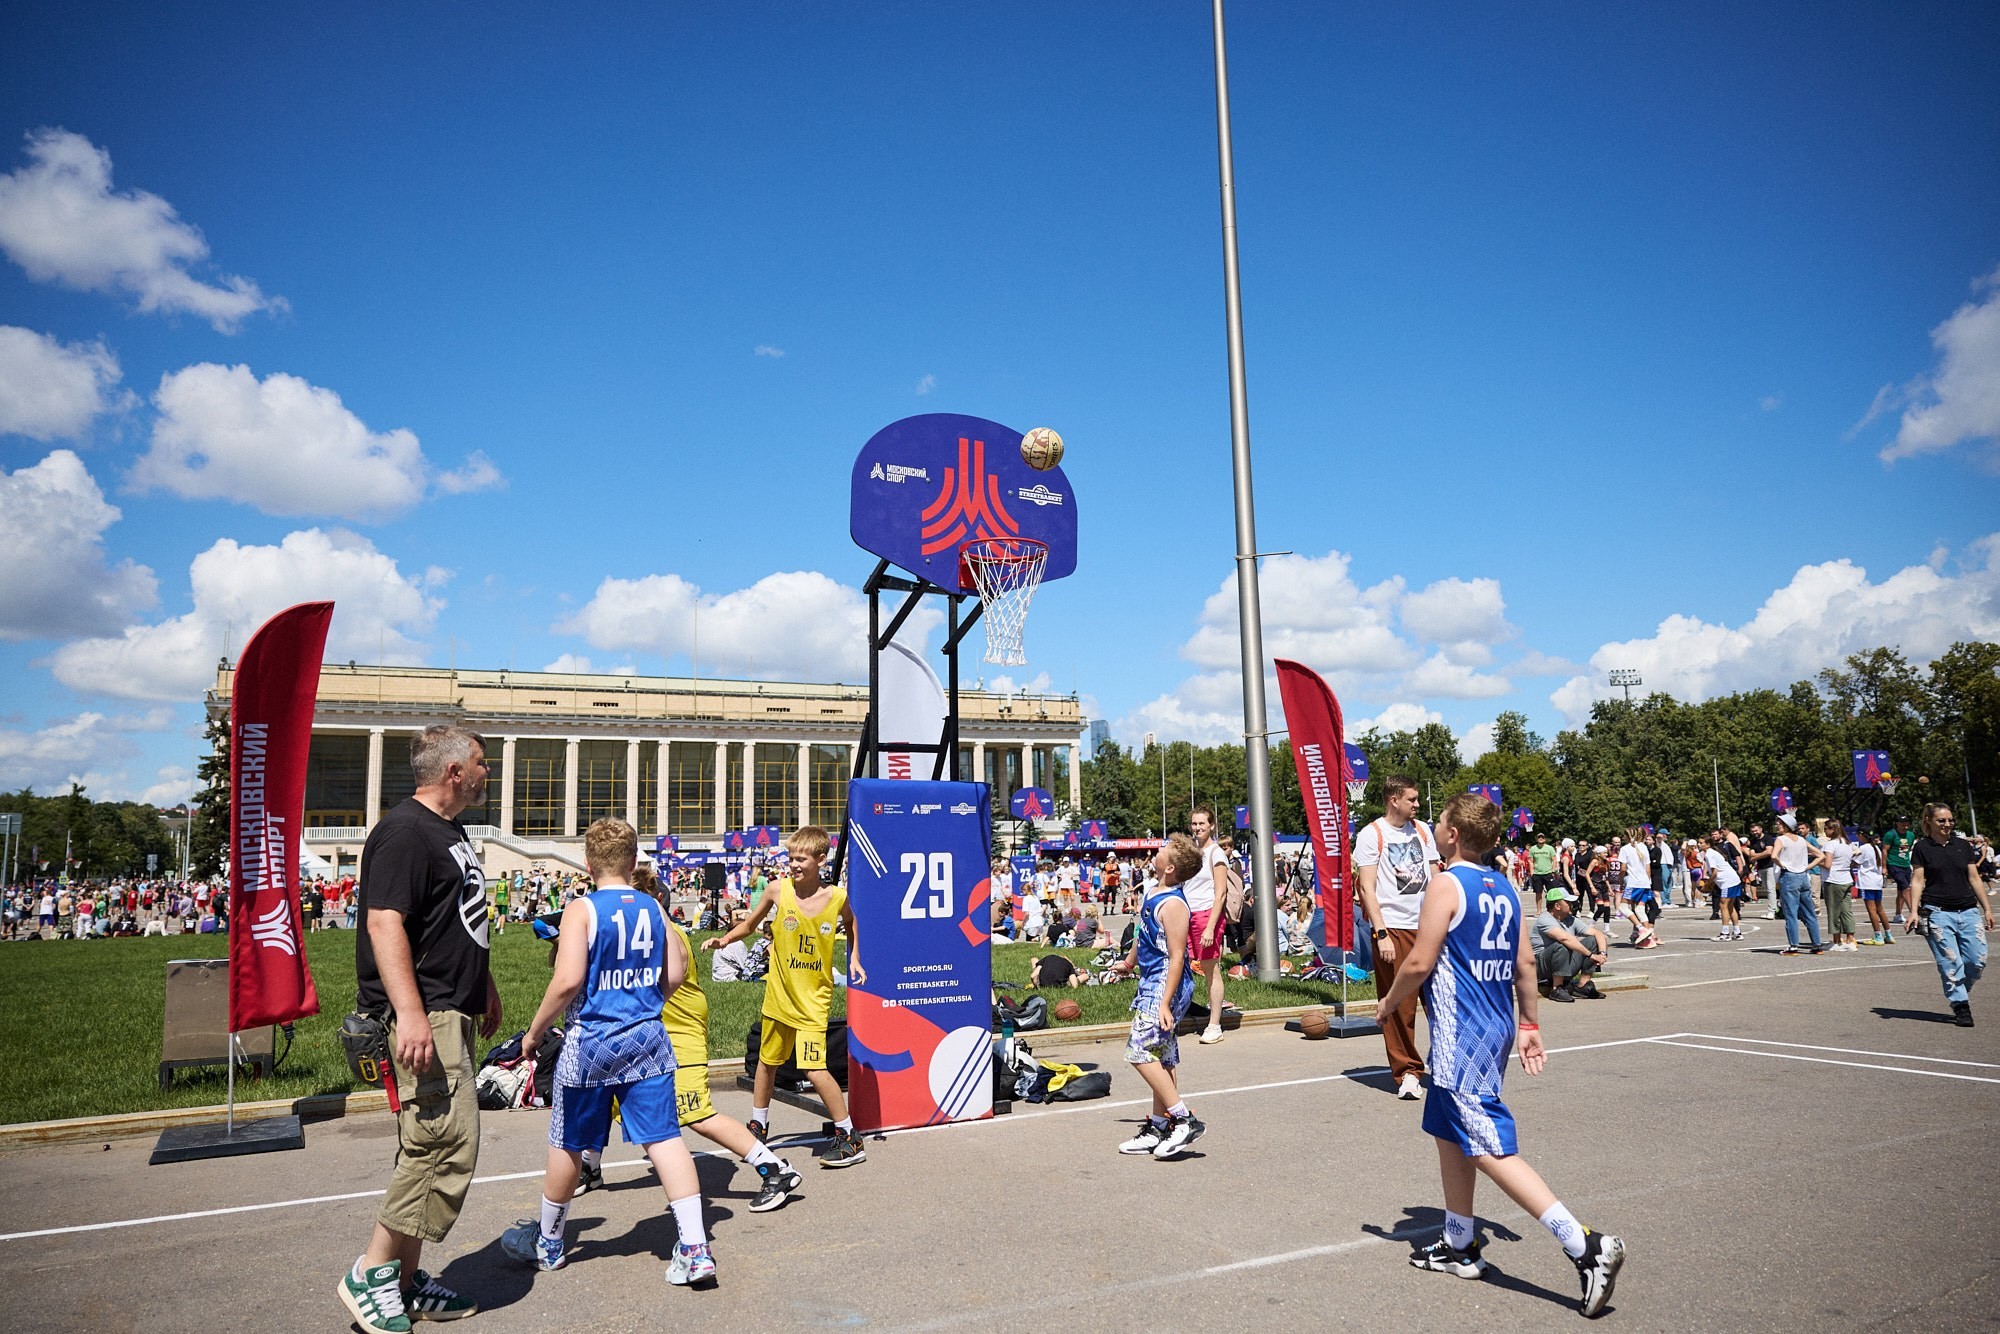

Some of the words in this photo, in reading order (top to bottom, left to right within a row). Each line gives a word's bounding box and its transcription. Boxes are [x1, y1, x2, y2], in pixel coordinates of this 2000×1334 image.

[886, 464, 927, 478] МОСКОВСКИЙ
[886, 472, 906, 483] СПОРТ
[239, 723, 269, 893] МОСКОВСКИЙ
[1300, 743, 1342, 857] МОСКОВСКИЙ
[266, 811, 287, 889] СПОРТ
[1096, 840, 1139, 848] РЕГИСТРАЦИЯ
[1020, 868, 1031, 882] 23
[900, 852, 954, 920] 29
[1478, 893, 1513, 950] 22
[611, 908, 654, 960] 14
[799, 934, 816, 955] 15
[903, 964, 953, 974] SPORT.MOS.RU
[897, 979, 959, 990] STREETBASKET.RU
[897, 994, 972, 1007] STREETBASKETRUSSIA
[803, 1041, 820, 1062] 15
